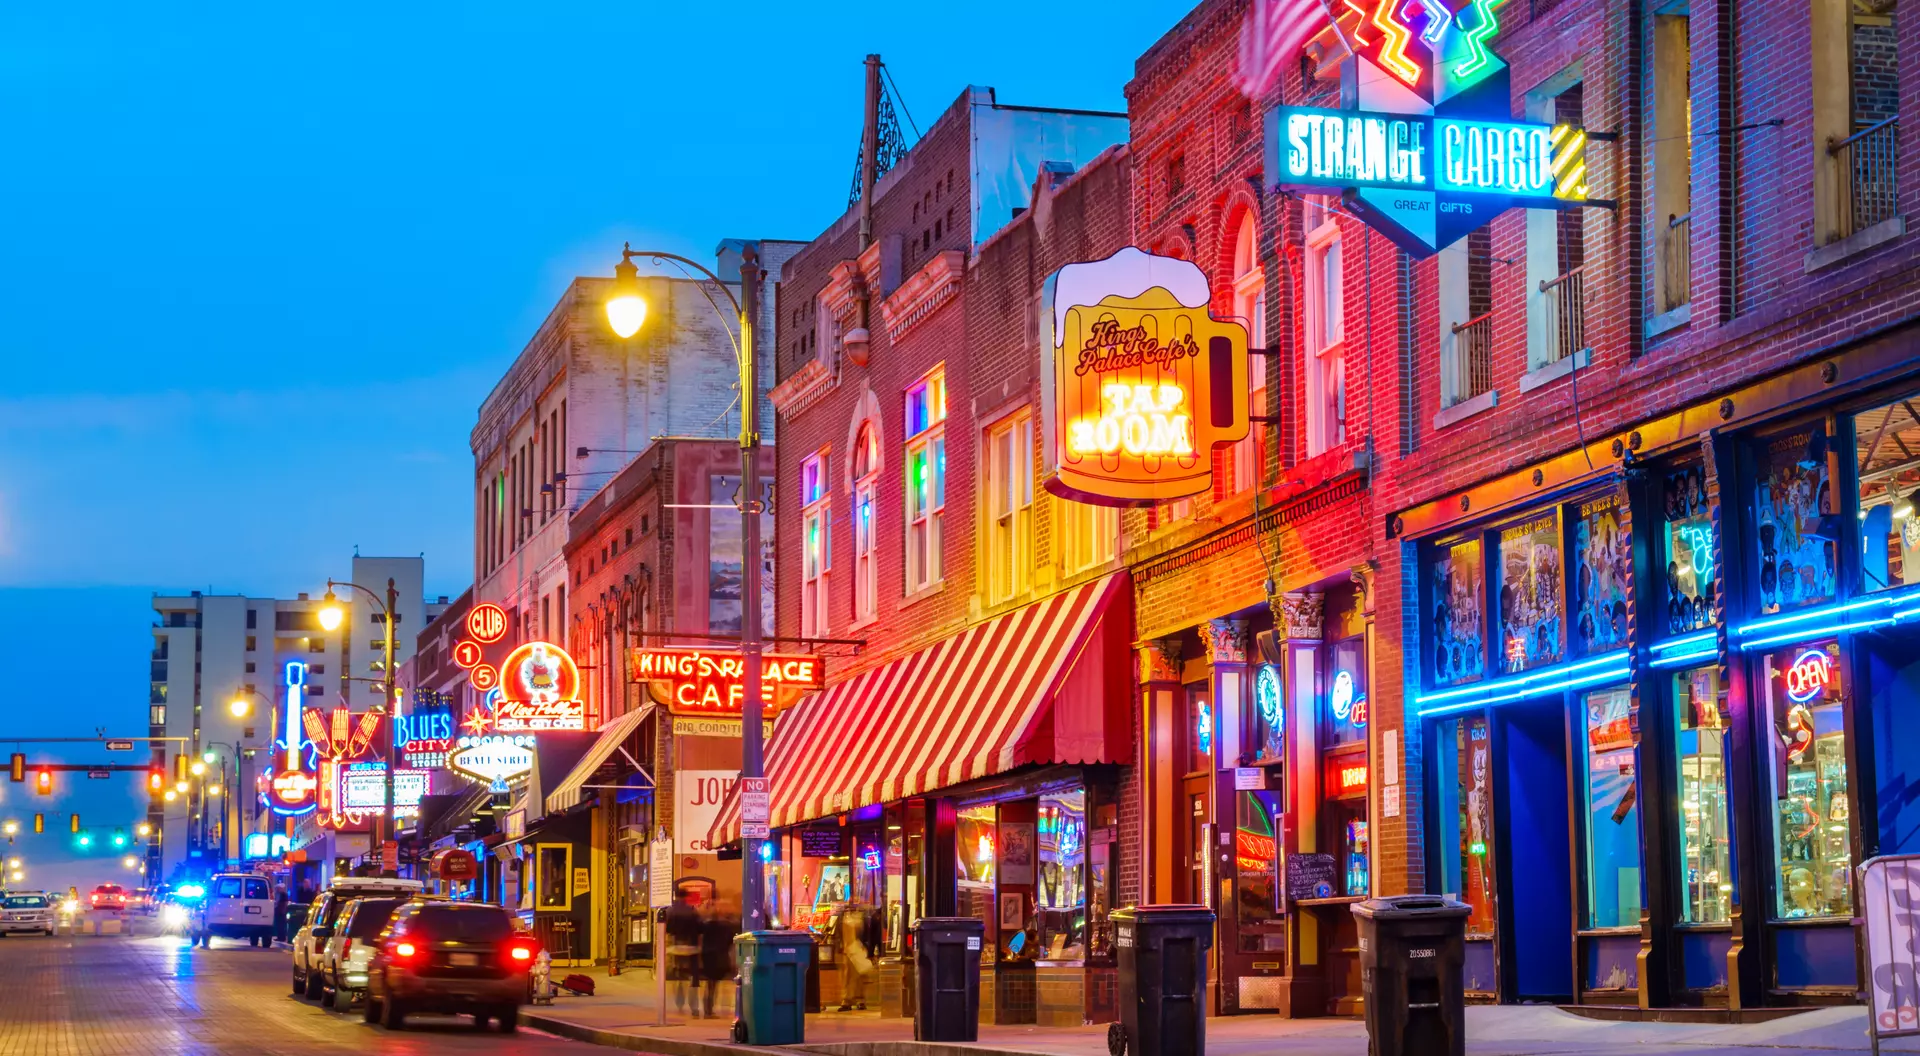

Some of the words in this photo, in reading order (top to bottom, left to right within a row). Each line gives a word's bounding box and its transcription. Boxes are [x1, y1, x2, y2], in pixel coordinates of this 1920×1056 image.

[1287, 113, 1426, 185] STRANGE
[1443, 122, 1551, 192] CARGO
[1394, 199, 1431, 212] GREAT
[1439, 202, 1473, 214] GIFTS
[1086, 319, 1147, 353] Kings
[1075, 348, 1142, 377] Palace
[1103, 383, 1184, 416] TAP
[1072, 413, 1193, 453] ROOM
[471, 611, 504, 637] CLUB
[462, 646, 472, 663] 1
[641, 651, 712, 677] KING'S
[721, 658, 814, 682] PAACE
[478, 670, 490, 685] 5
[1787, 660, 1829, 694] OPEN
[398, 713, 450, 747] BLUES
[406, 740, 450, 751] CITY
[746, 780, 764, 790] NO
[1117, 937, 1133, 948] STREET
